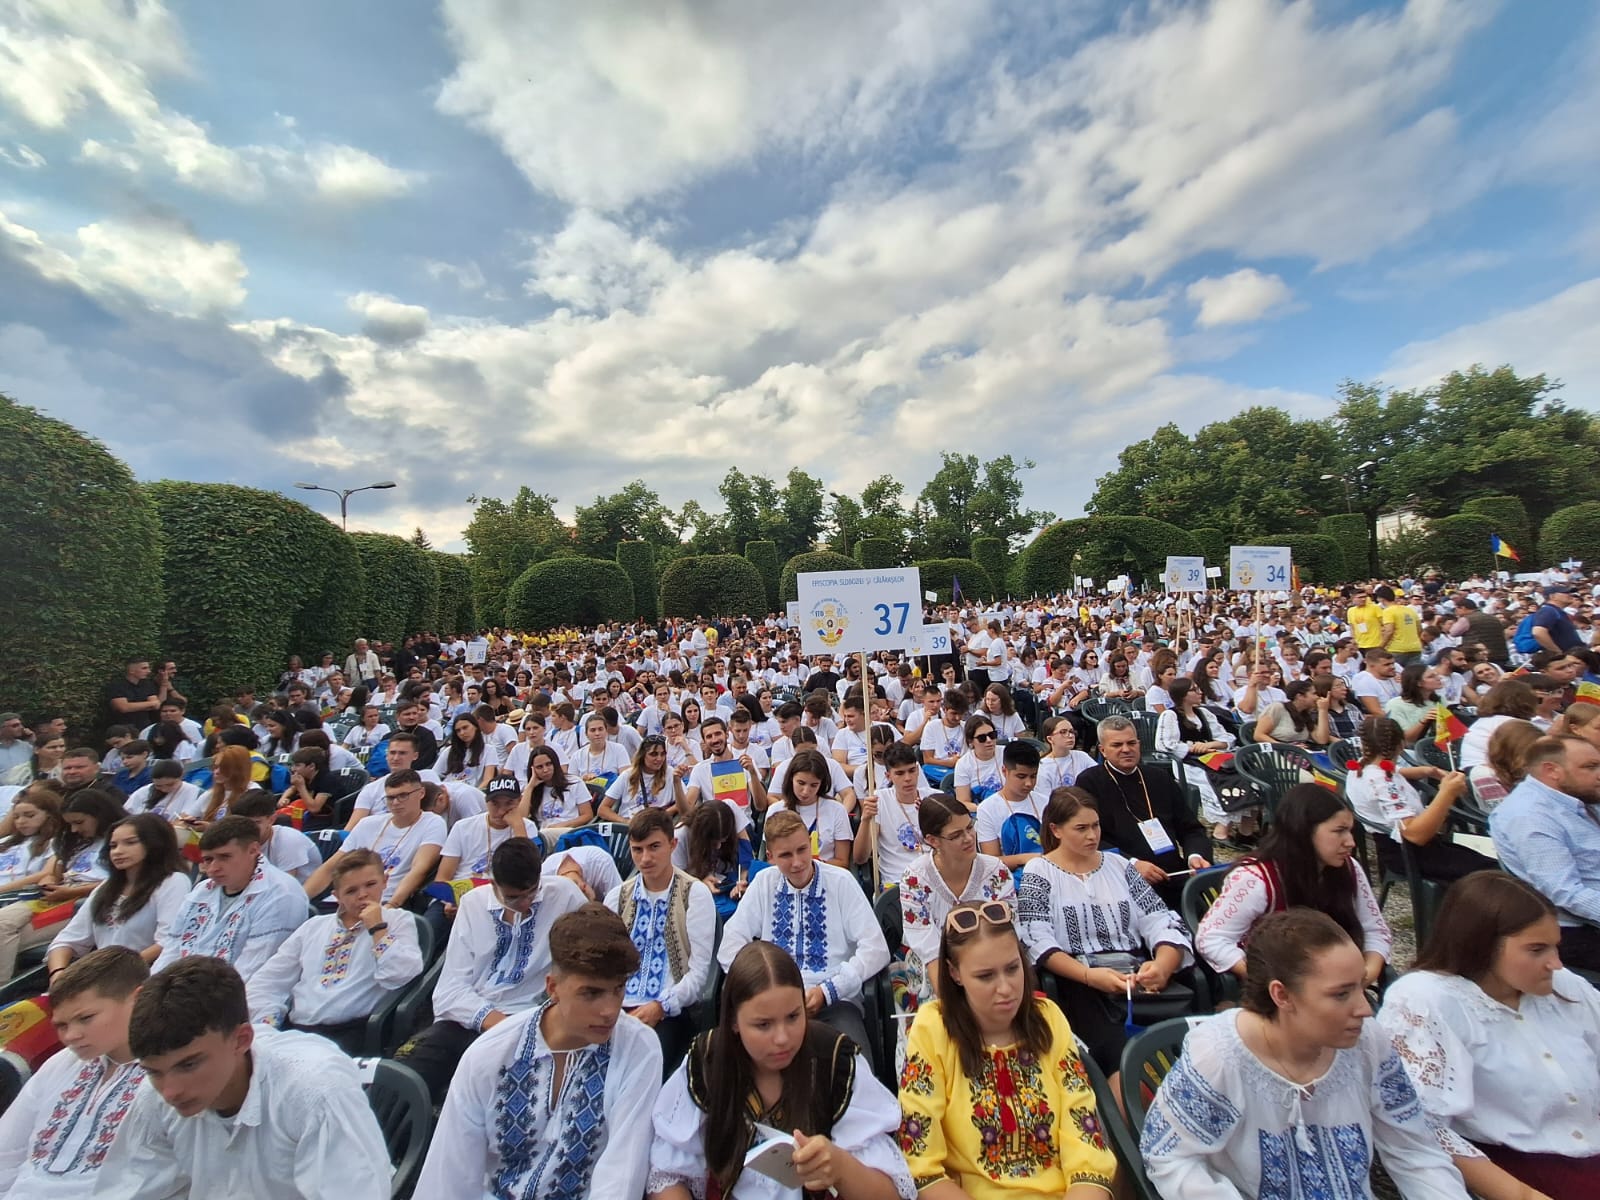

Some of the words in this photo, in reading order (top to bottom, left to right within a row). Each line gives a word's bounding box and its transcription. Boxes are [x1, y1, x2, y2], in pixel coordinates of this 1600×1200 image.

[1187, 569, 1200, 581] 39
[1266, 565, 1286, 582] 34
[812, 579, 838, 587] EPISCOPIA
[873, 602, 910, 635] 37
[932, 636, 947, 649] 39
[490, 778, 516, 792] BLACK
[323, 831, 329, 839] F
[602, 825, 609, 834] F
